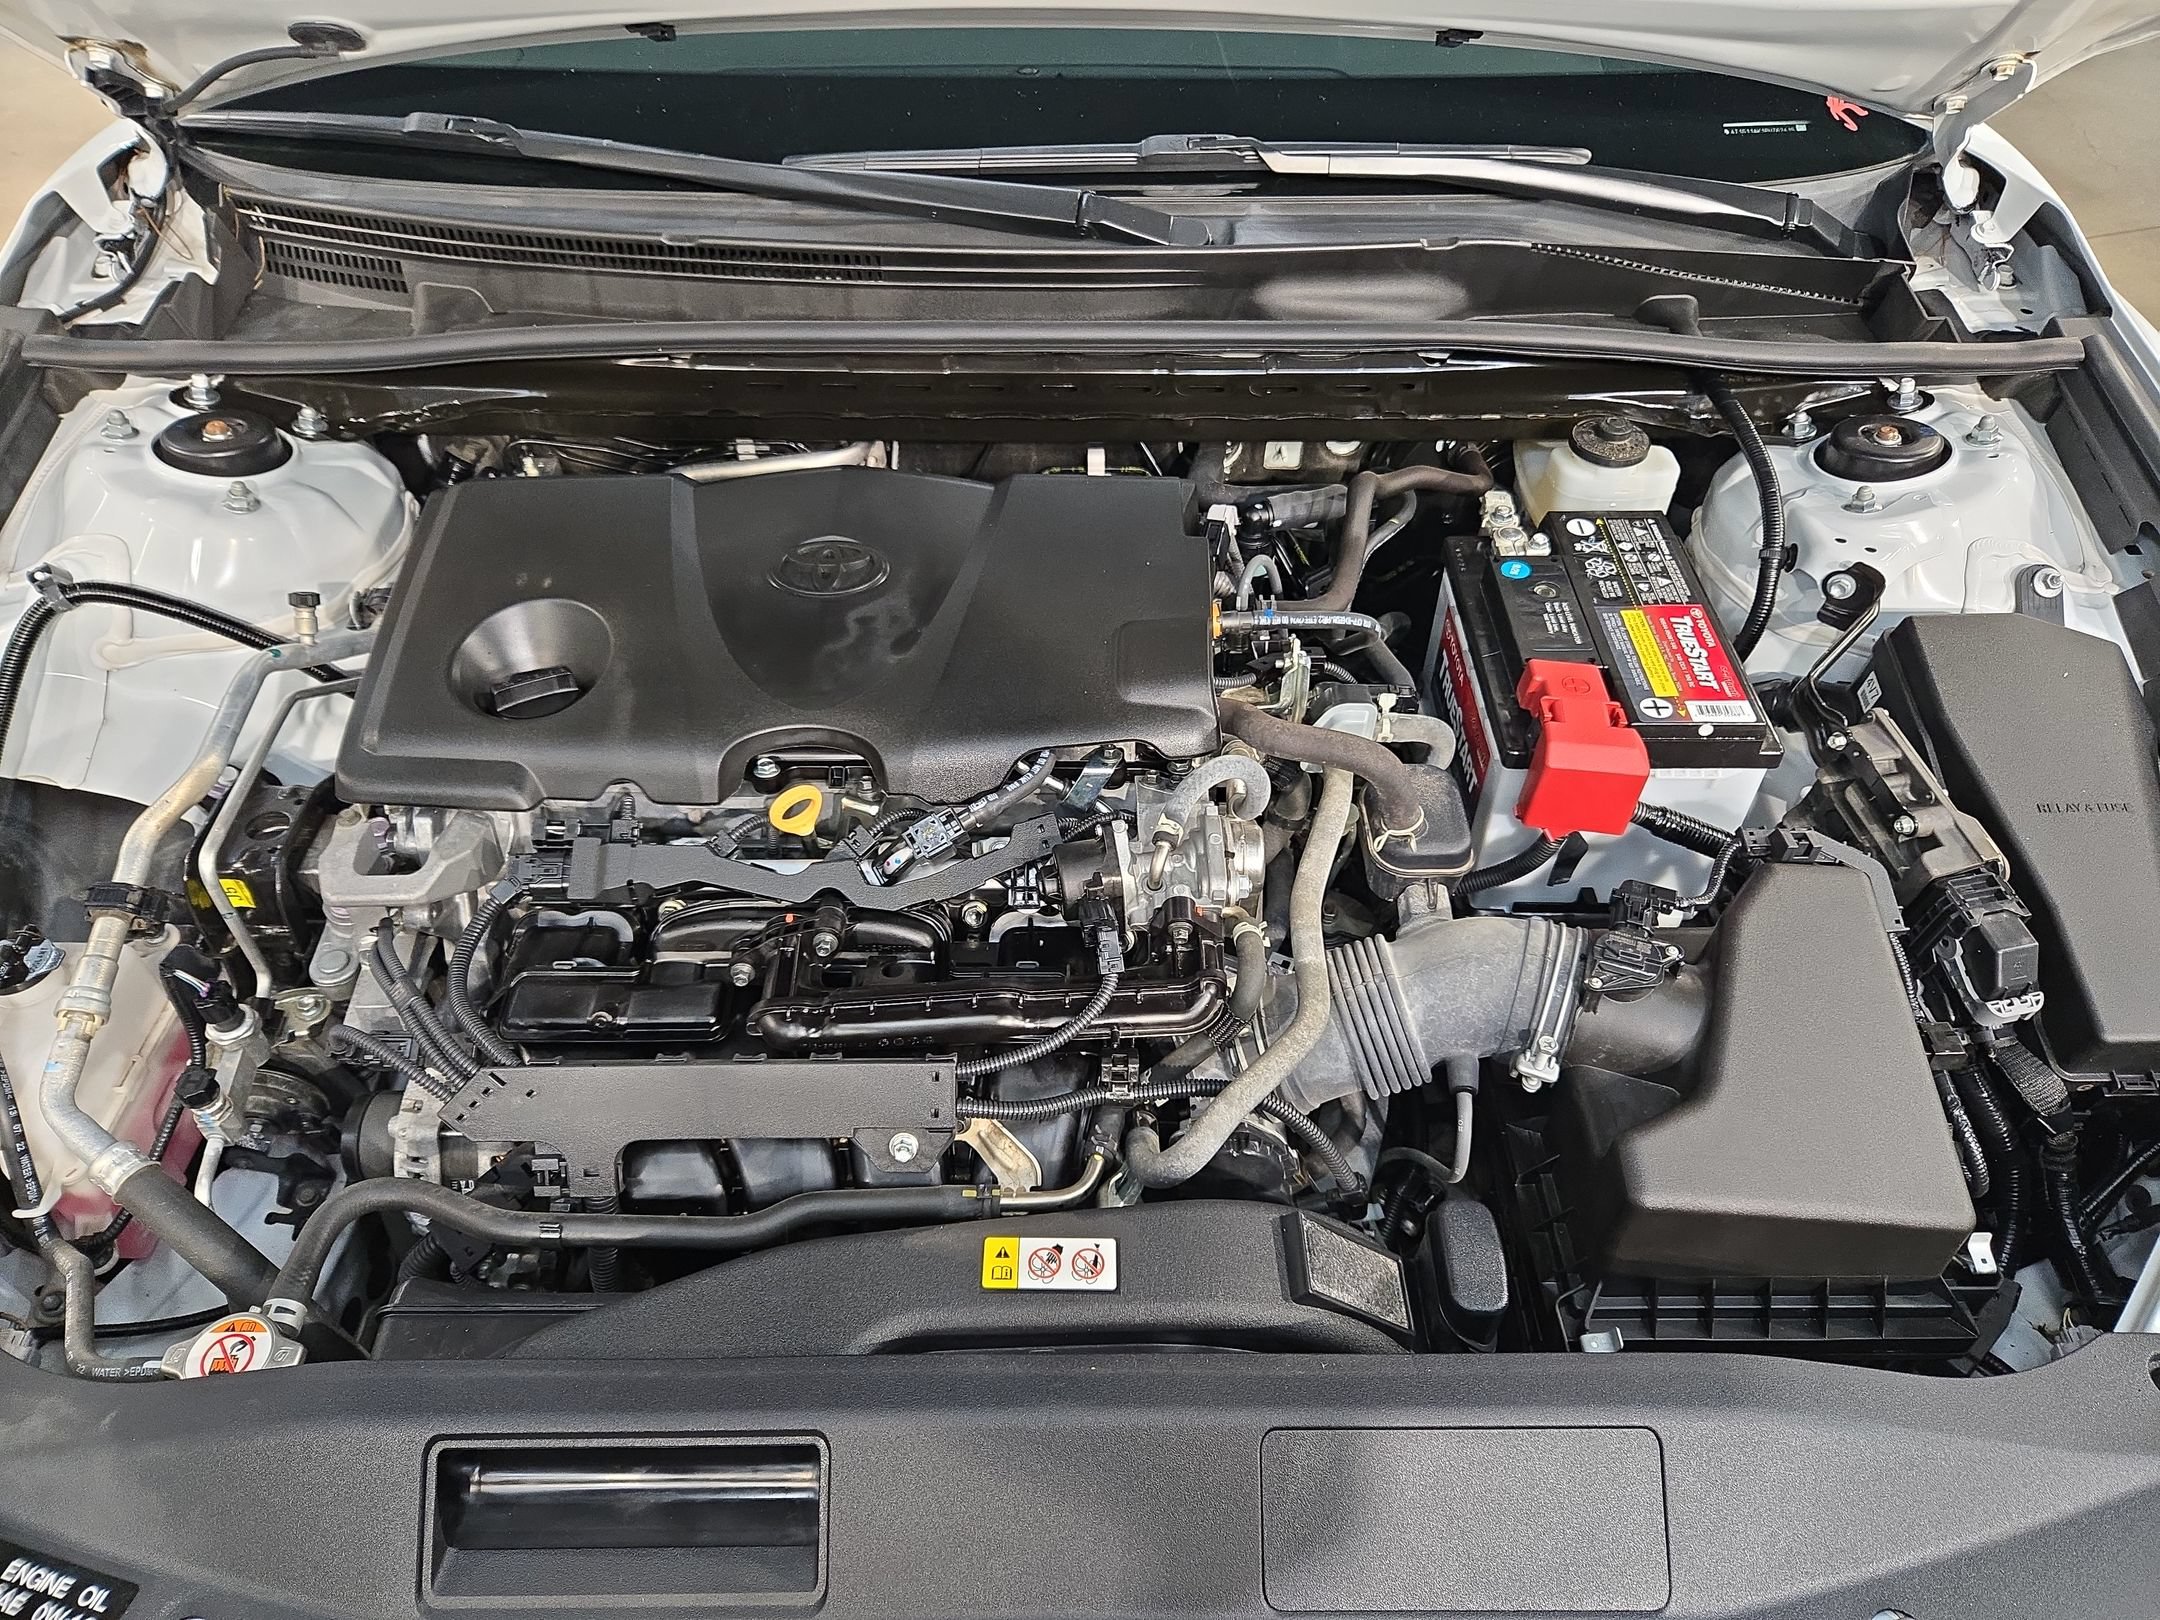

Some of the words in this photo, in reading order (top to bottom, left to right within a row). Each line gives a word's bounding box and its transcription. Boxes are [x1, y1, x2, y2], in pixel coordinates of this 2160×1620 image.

[1667, 615, 1724, 689] TRUESTART
[1694, 619, 1717, 647] TOYOTA
[1440, 648, 1478, 793] TRUESTART
[91, 1366, 121, 1377] WATER
[1, 1557, 77, 1600] ENGINE
[78, 1585, 113, 1614] OIL
